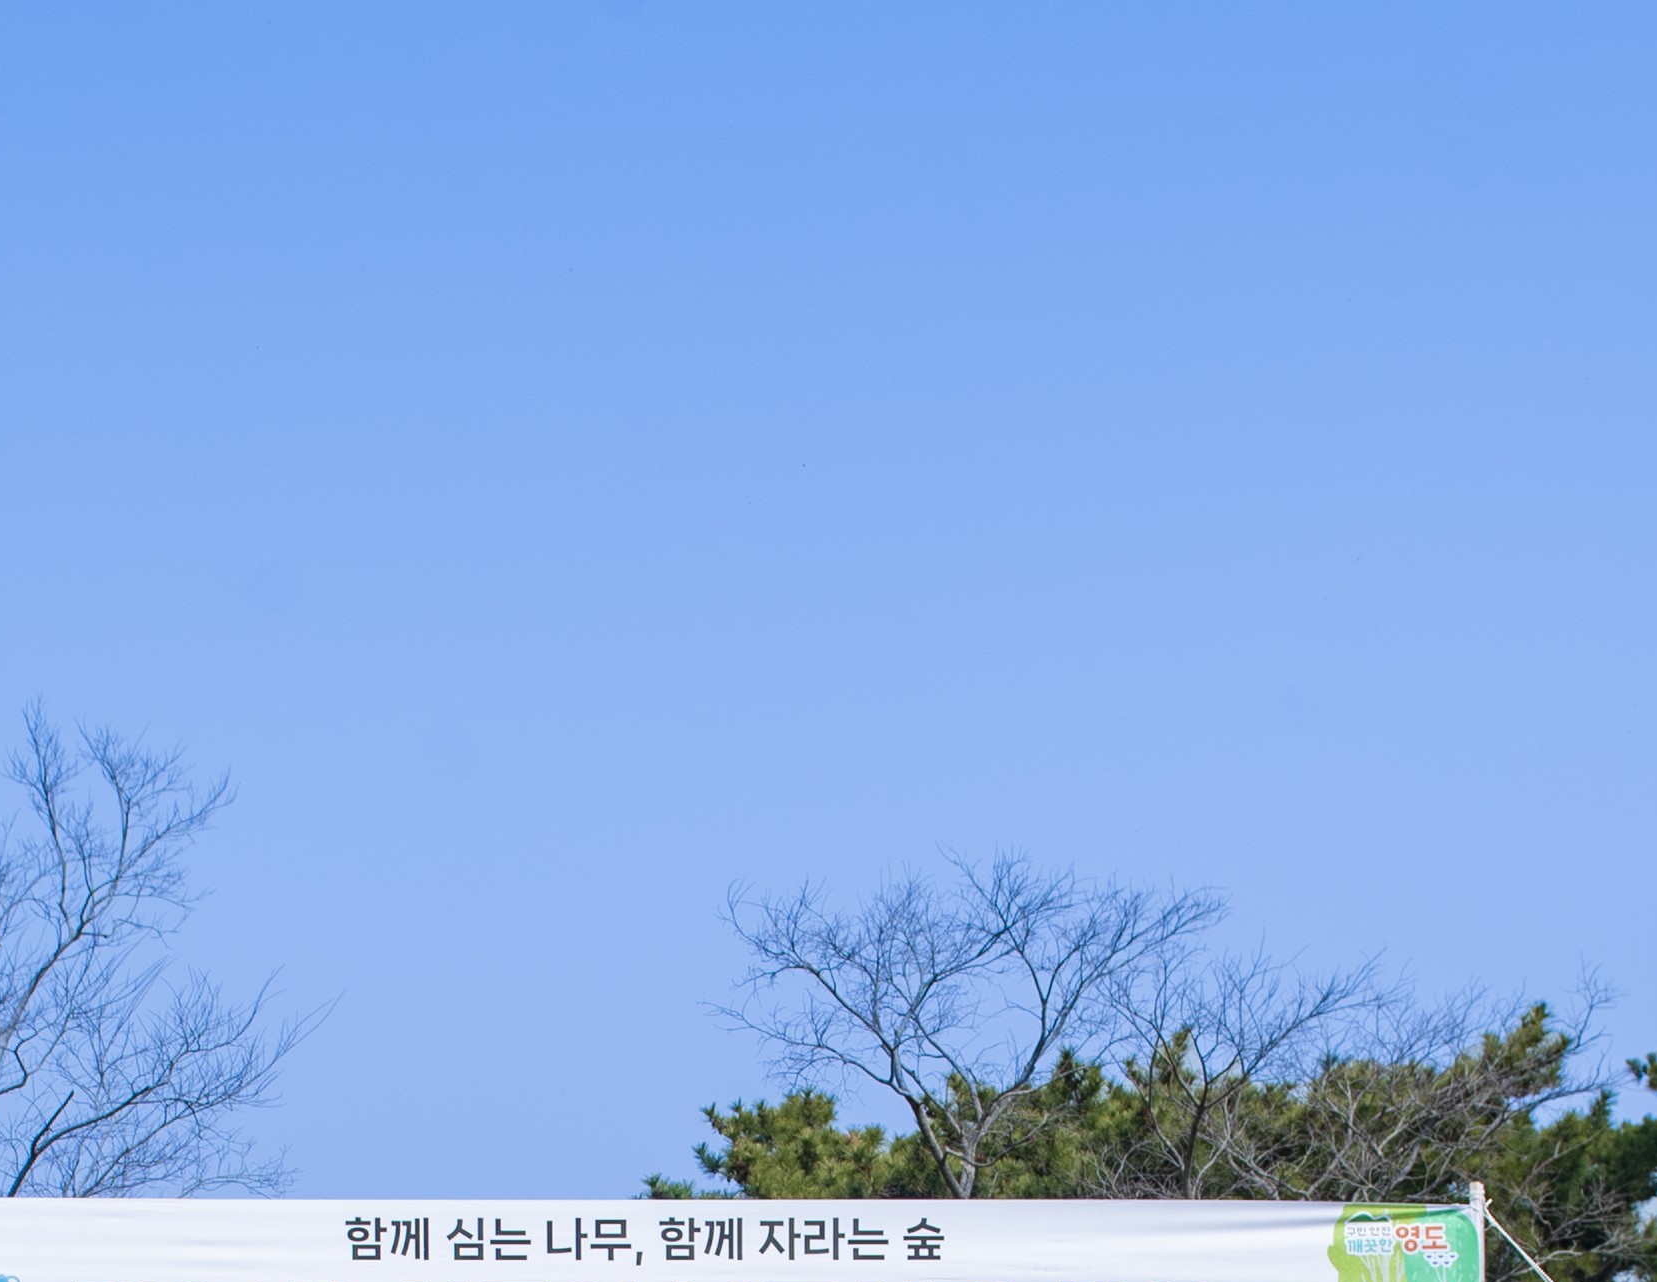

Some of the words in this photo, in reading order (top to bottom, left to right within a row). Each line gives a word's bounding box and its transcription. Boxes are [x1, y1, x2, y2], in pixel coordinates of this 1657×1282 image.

[346, 1217, 429, 1260] 함께
[447, 1218, 531, 1260] 심는
[547, 1218, 642, 1265] 나무,
[660, 1218, 742, 1260] 함께
[759, 1218, 888, 1260] 자라는
[904, 1218, 944, 1260] 숲
[1347, 1239, 1393, 1253] 깨끗한
[1395, 1225, 1448, 1252] 영도
